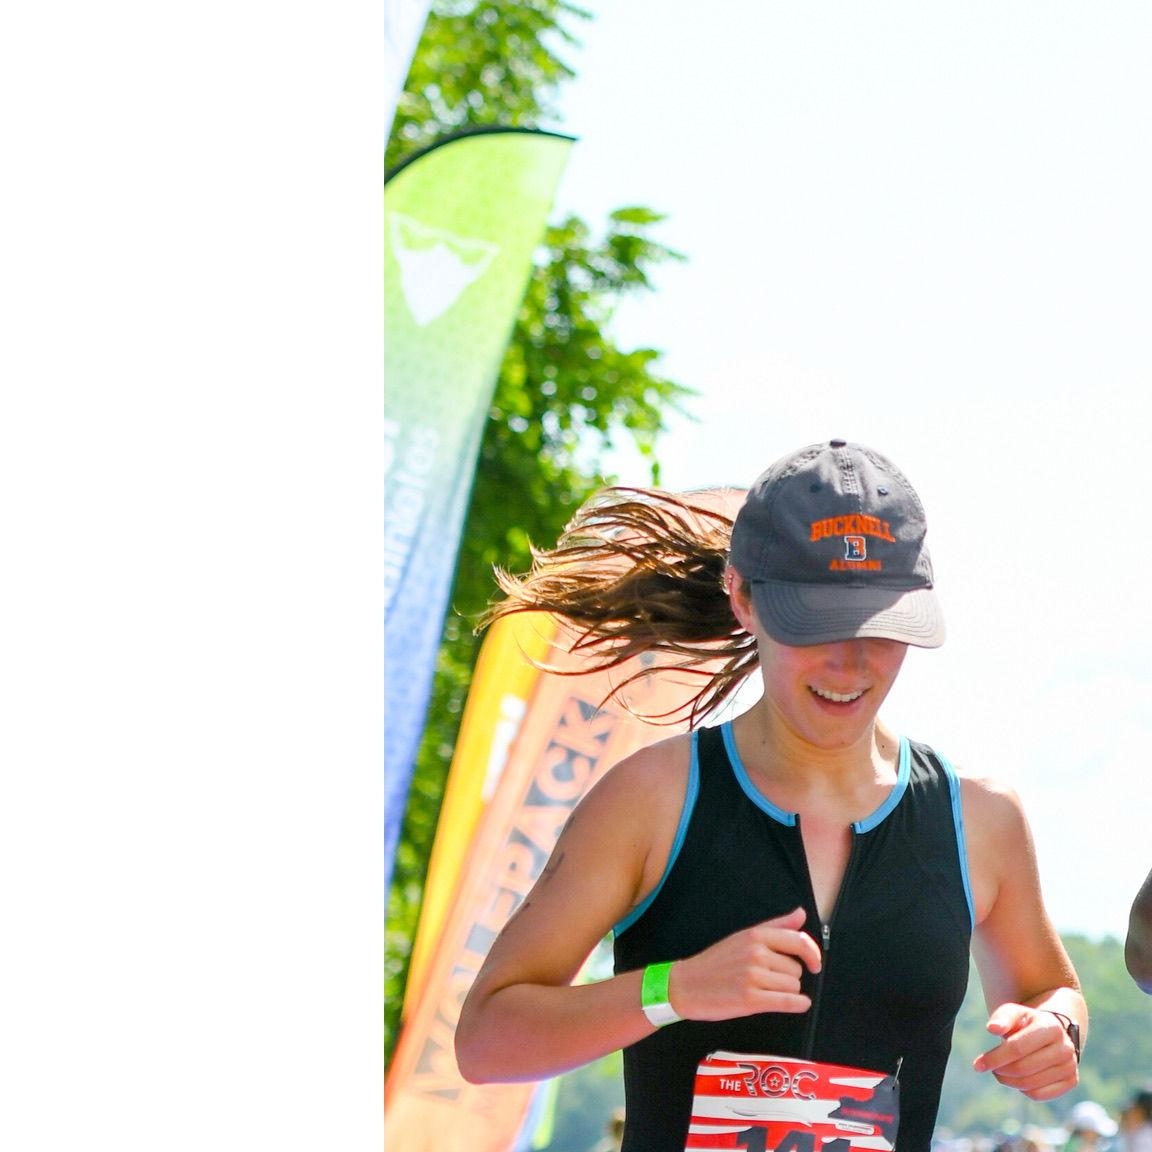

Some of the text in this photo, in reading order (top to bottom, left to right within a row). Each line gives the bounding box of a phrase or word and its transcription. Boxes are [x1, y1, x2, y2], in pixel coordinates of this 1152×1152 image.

[809, 512, 896, 542] BUCKNELL
[844, 535, 866, 561] B
[719, 1062, 819, 1101] THE ROC
